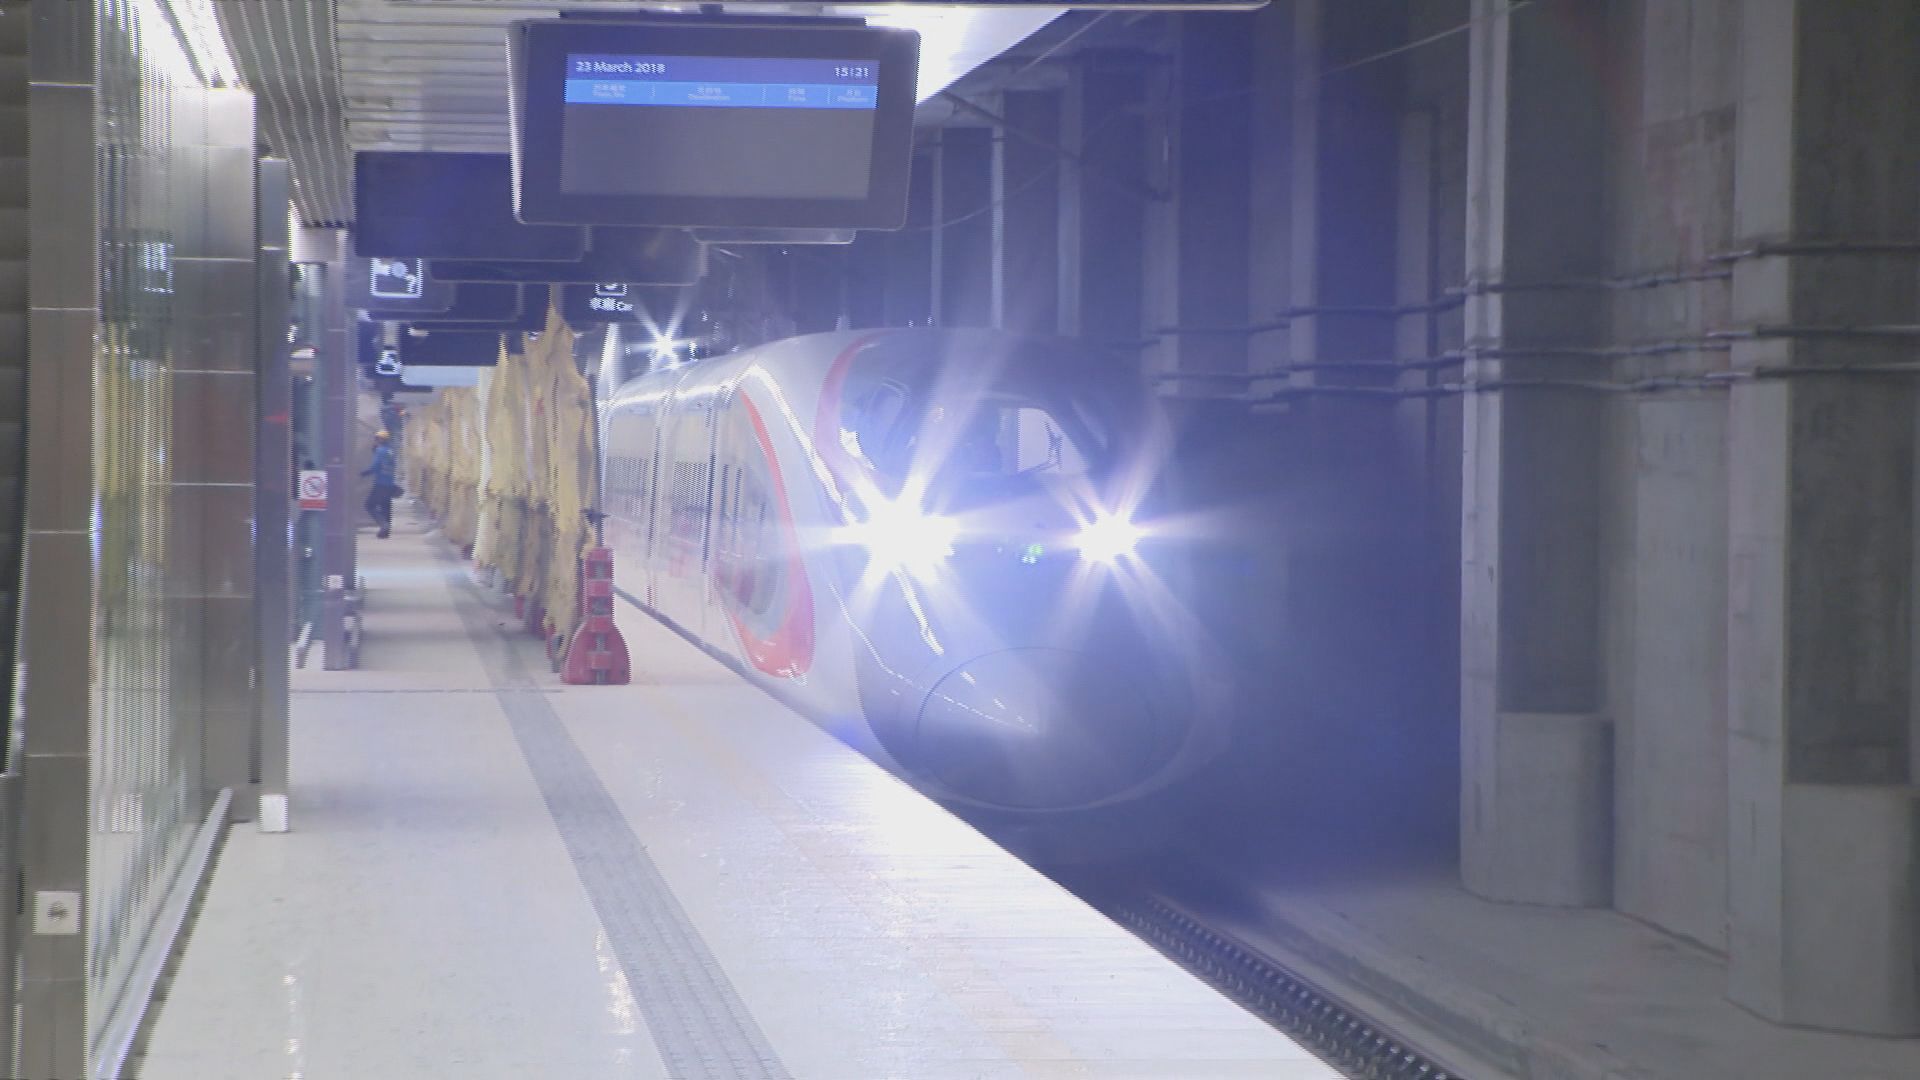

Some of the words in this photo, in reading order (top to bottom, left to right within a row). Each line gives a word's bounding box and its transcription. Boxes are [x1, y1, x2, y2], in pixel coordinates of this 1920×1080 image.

[575, 61, 592, 73] 23
[593, 61, 633, 73] March
[634, 62, 667, 74] 2018
[834, 66, 870, 78] 15:21
[616, 301, 633, 311] Car
